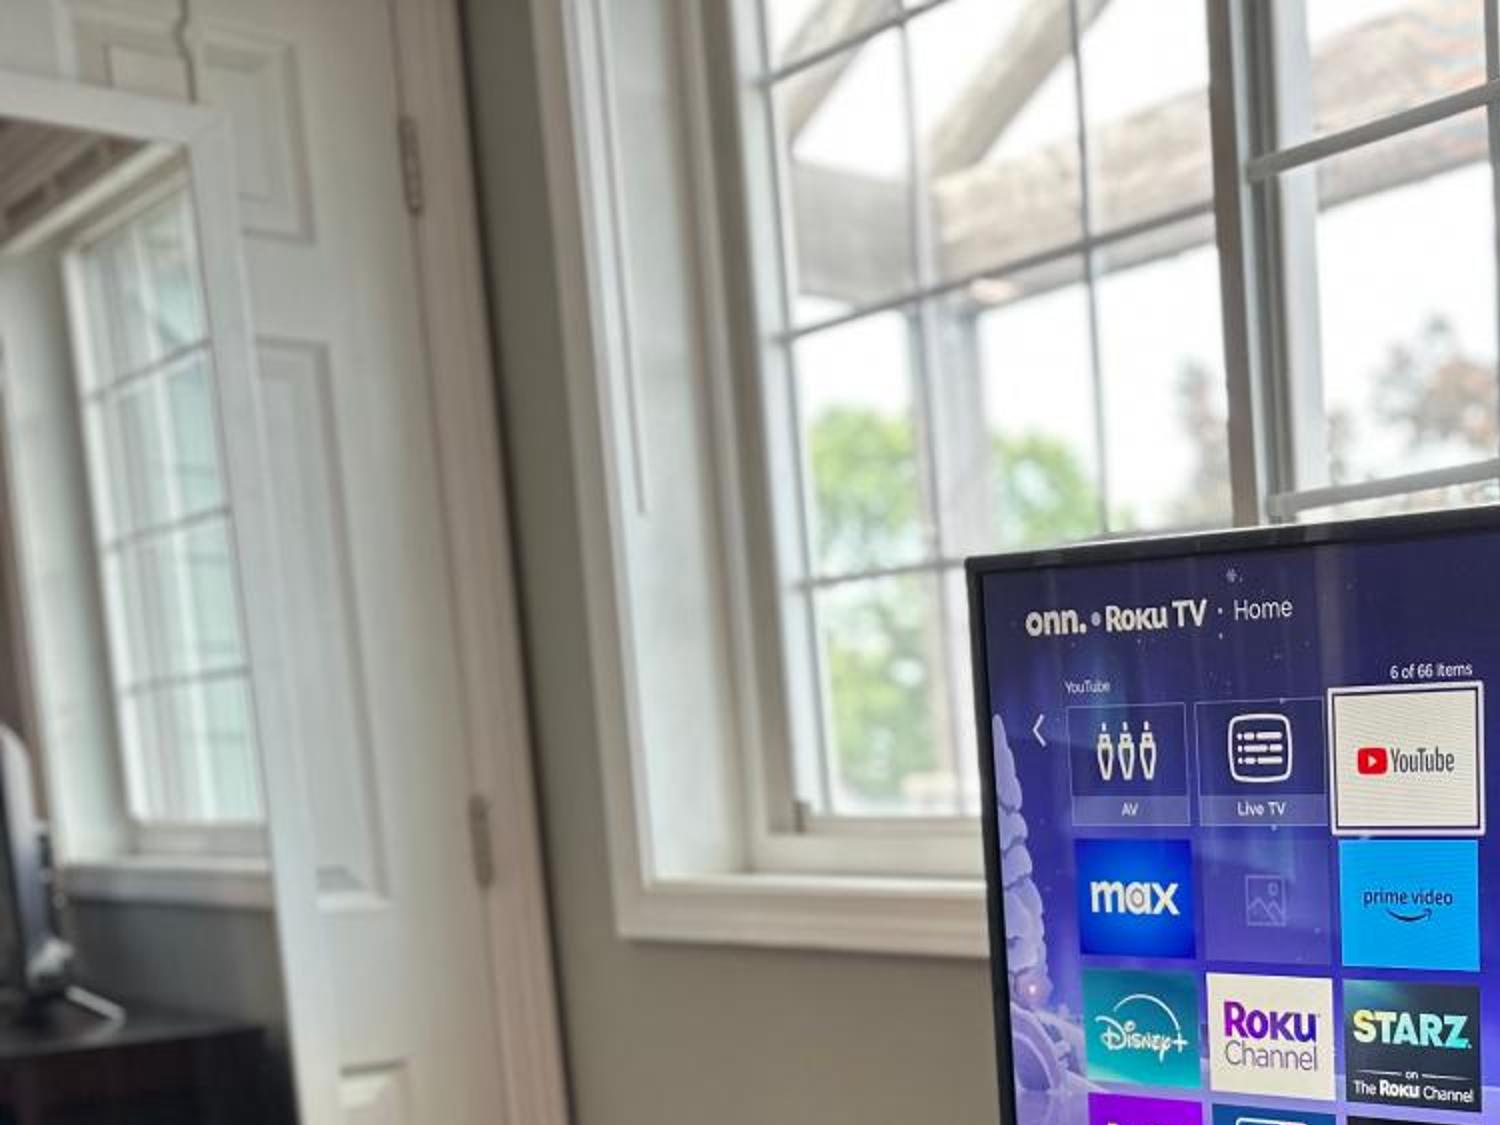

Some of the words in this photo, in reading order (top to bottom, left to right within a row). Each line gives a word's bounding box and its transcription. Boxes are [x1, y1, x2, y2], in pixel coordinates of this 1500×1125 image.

[1025, 610, 1088, 636] onn.
[1105, 605, 1168, 632] Roku
[1171, 599, 1207, 627] TV
[1233, 600, 1293, 621] Home
[1390, 665, 1399, 679] 6
[1401, 663, 1415, 679] of
[1417, 664, 1433, 678] 66
[1065, 681, 1111, 693] YouTube
[1390, 746, 1455, 773] YouTube
[1121, 803, 1139, 816] AV
[1237, 802, 1264, 816] Live
[1270, 802, 1287, 816] TV
[1090, 881, 1180, 915] max
[1363, 889, 1407, 908] prime
[1411, 890, 1454, 905] video
[1223, 1001, 1317, 1042] Roku
[1224, 1039, 1318, 1072] Channel
[1405, 1071, 1419, 1080] on
[1354, 1080, 1377, 1095] The
[1423, 1085, 1474, 1103] Channel
